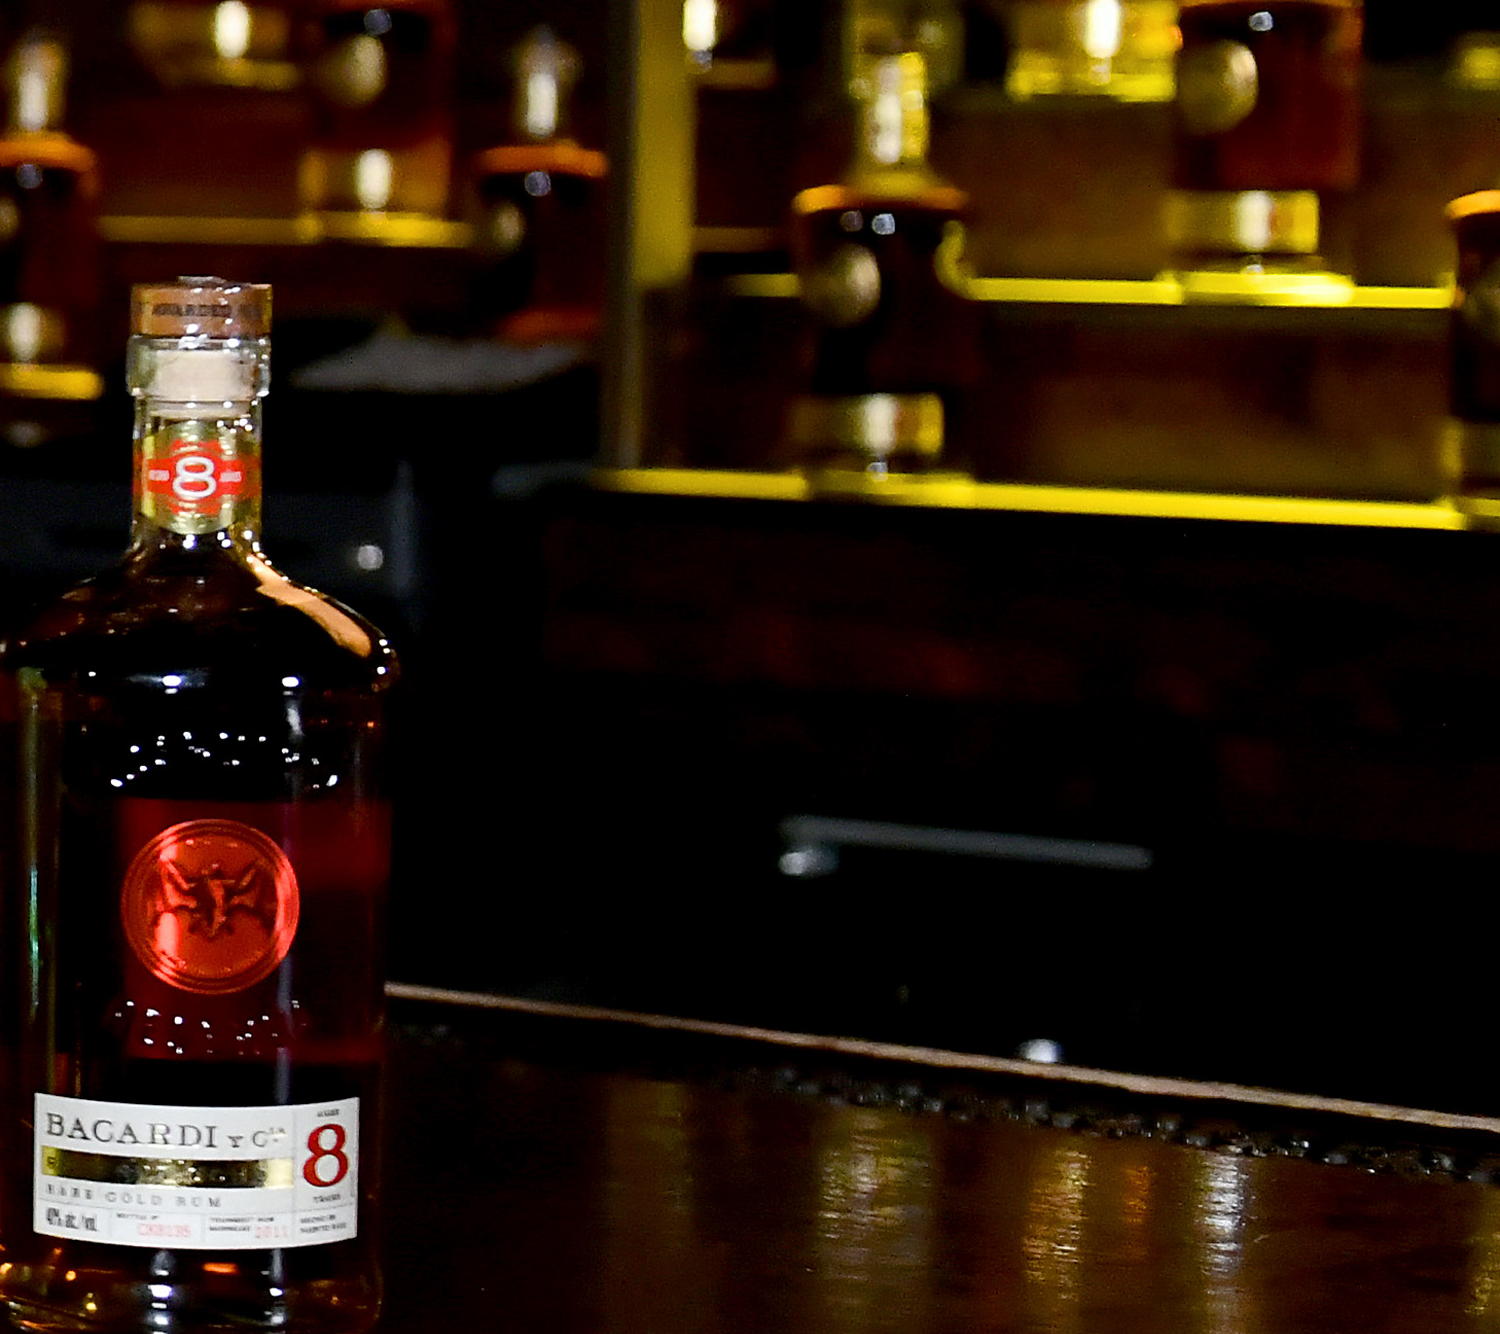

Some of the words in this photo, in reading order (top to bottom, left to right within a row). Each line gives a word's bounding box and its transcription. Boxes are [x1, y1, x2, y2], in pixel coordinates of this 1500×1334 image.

[171, 455, 218, 499] 8
[303, 1123, 349, 1187] 8
[105, 1190, 162, 1206] GOLD
